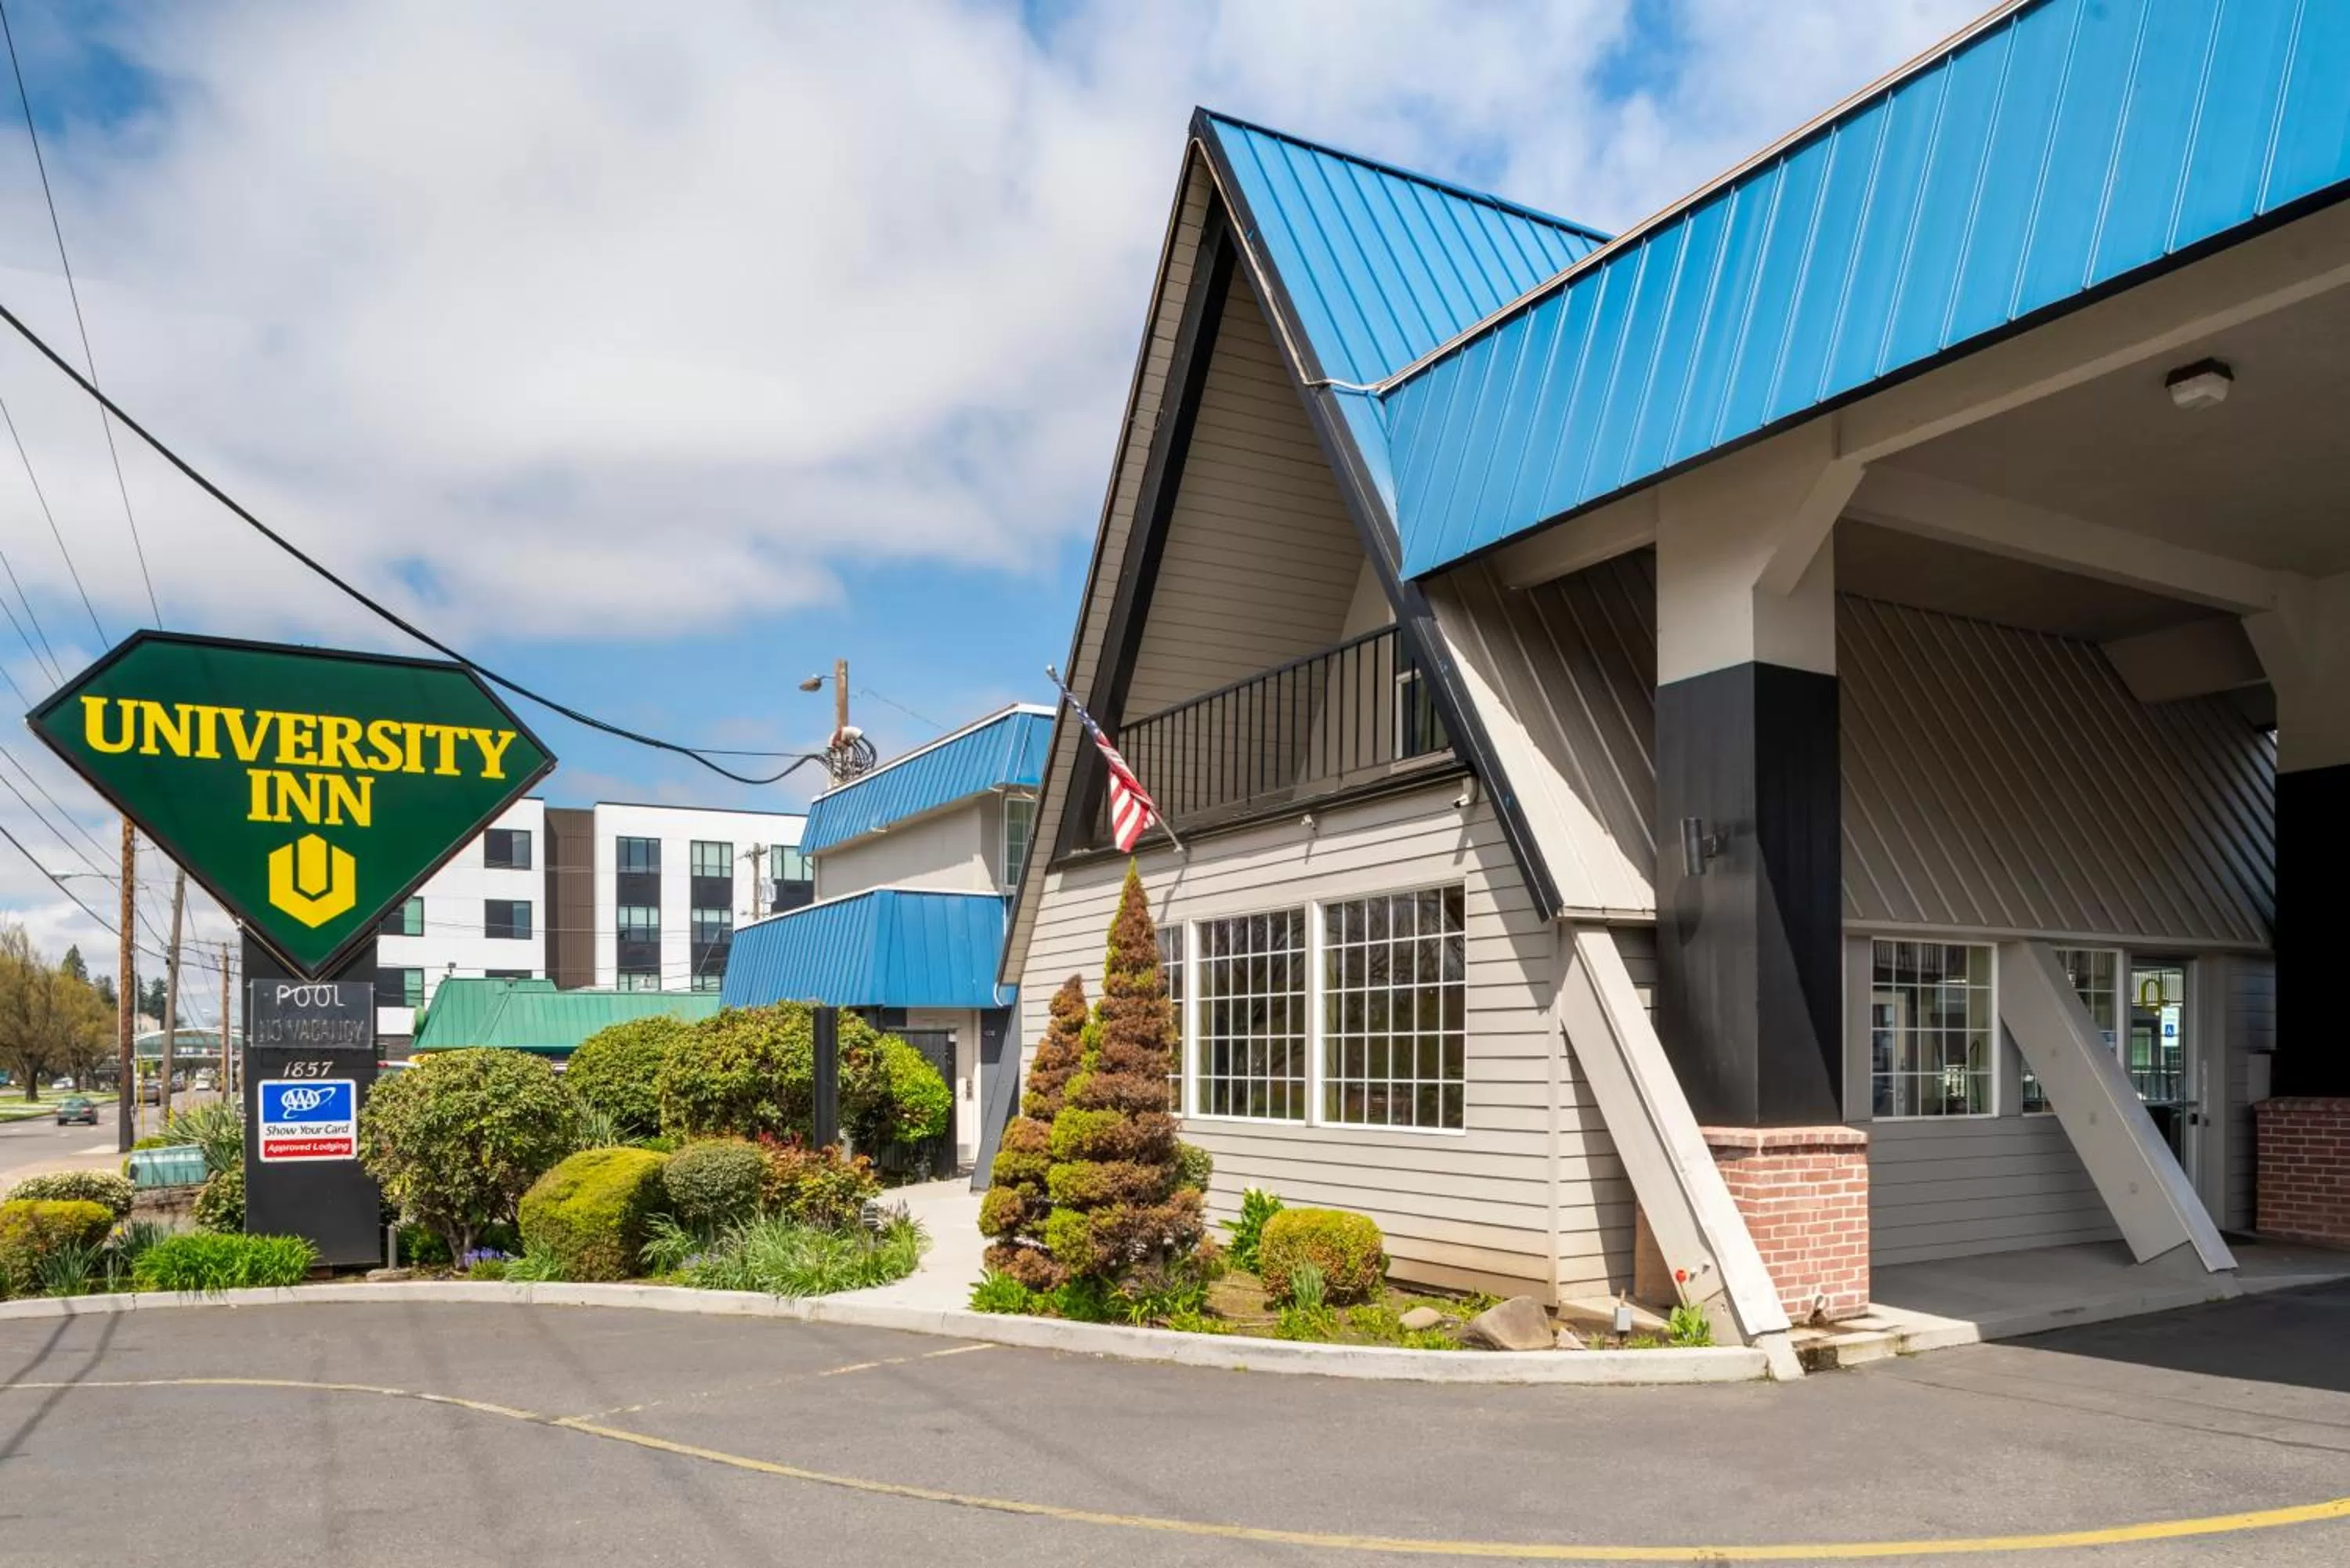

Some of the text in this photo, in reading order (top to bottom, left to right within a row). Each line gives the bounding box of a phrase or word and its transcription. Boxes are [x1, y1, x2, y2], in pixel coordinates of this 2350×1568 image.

[81, 695, 516, 779] UNIVERSITY
[247, 768, 375, 827] INN
[276, 985, 346, 1008] POOL
[287, 1019, 364, 1042] VACANCY
[283, 1060, 334, 1078] 1857
[284, 1088, 318, 1111] AAA
[266, 1123, 350, 1136] Show Your Card
[267, 1141, 350, 1153] Approved Lodging
